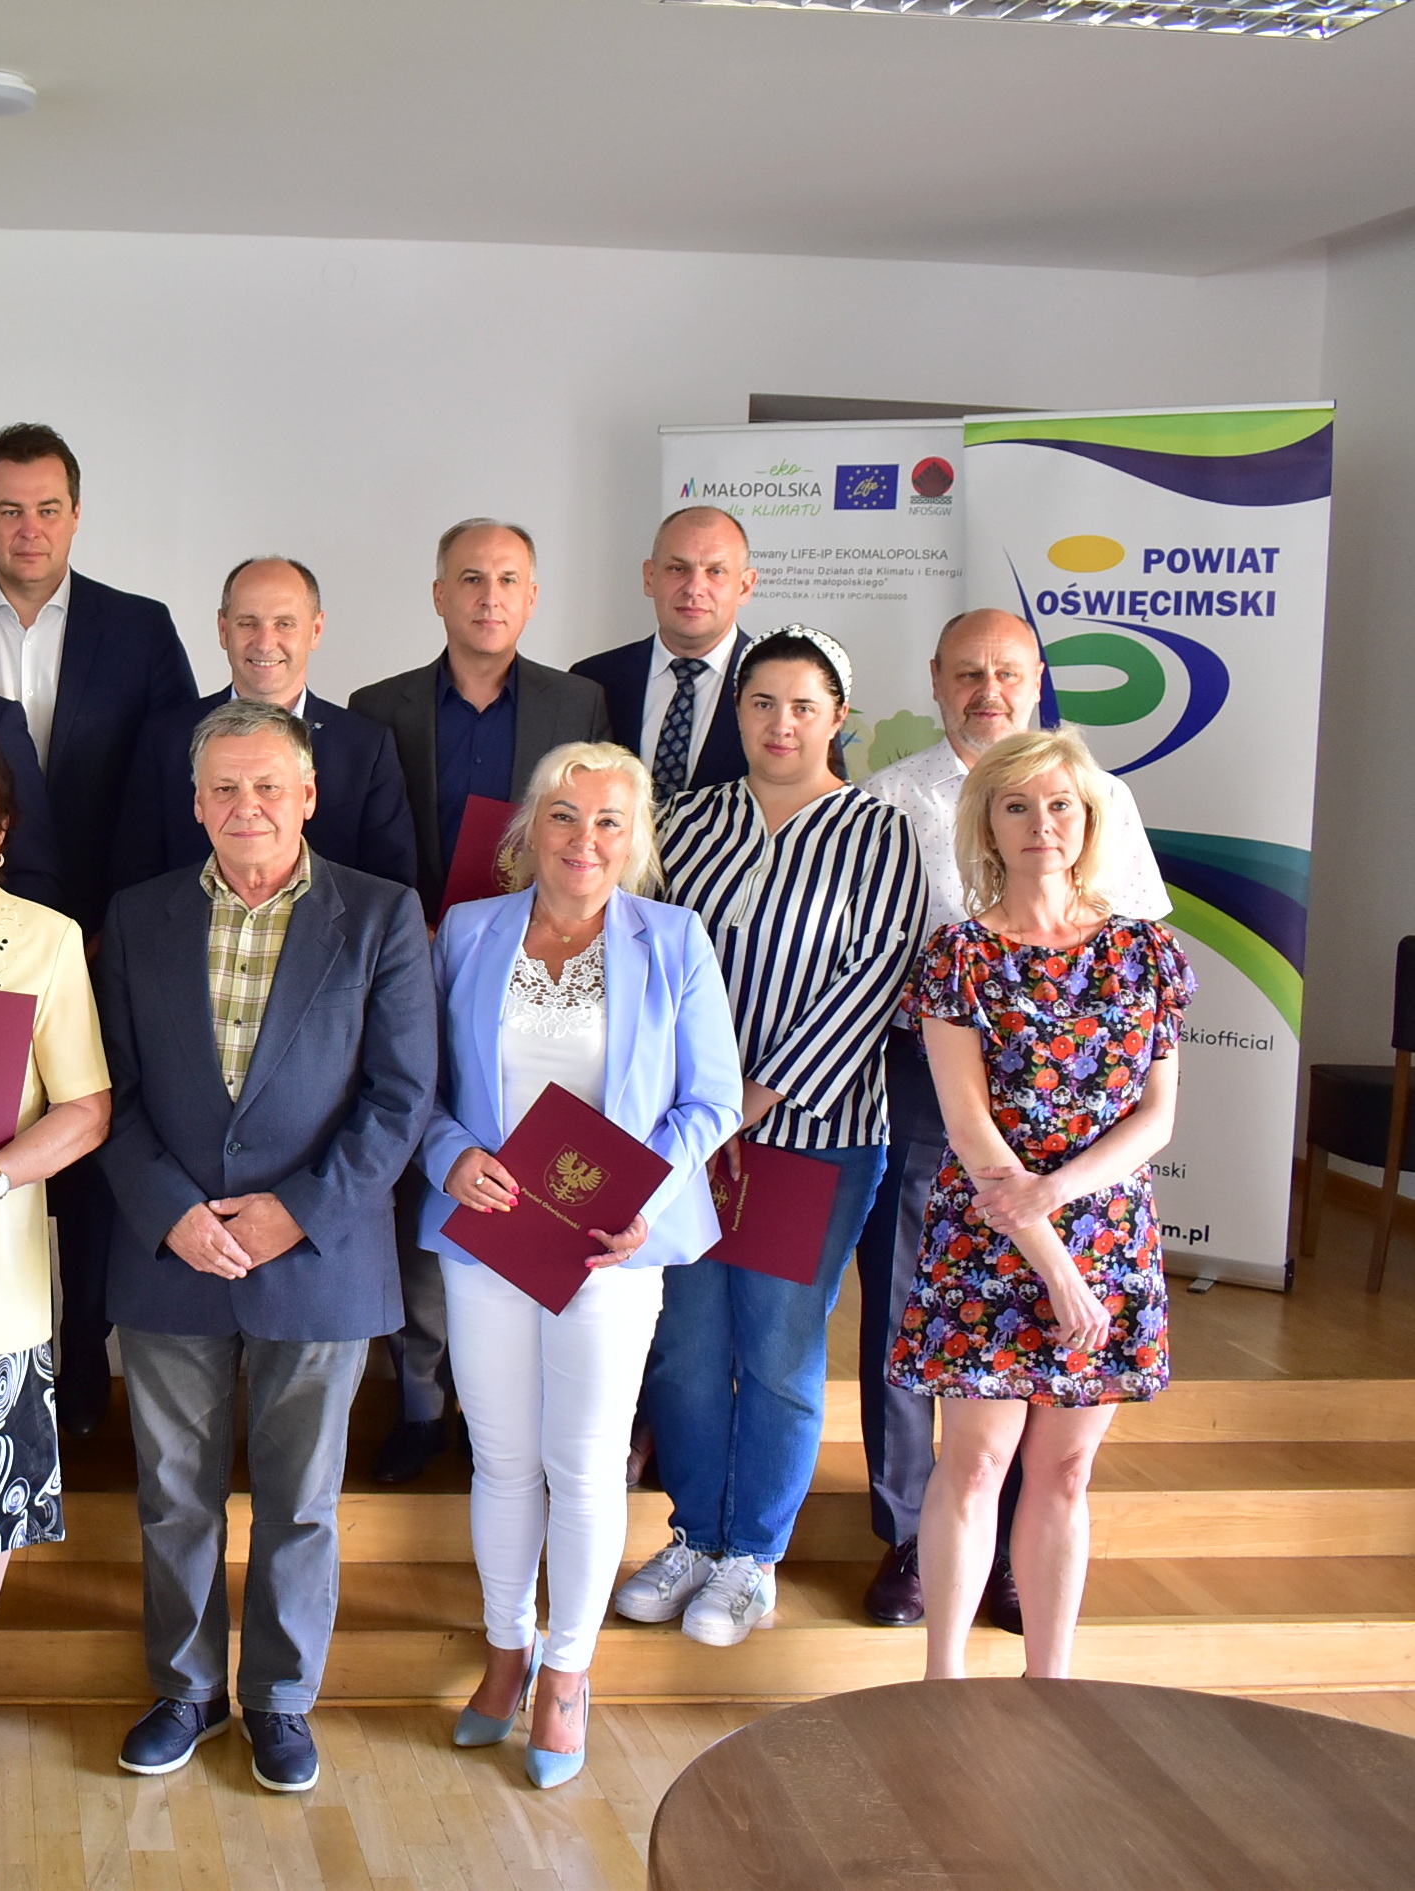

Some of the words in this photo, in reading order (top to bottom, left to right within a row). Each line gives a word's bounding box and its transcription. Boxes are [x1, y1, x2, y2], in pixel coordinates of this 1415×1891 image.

[702, 482, 822, 498] MAŁOPOLSKA
[752, 503, 822, 517] KLIMATU
[748, 550, 788, 560] rowany
[791, 548, 833, 559] LIFE-IP
[835, 548, 949, 560] EKOMALOPOLSKA
[1142, 547, 1281, 574] POWIAT
[757, 566, 784, 576] lnego
[786, 565, 815, 575] Planu
[817, 566, 855, 575] Działań
[857, 566, 873, 576] dla
[876, 567, 915, 576] Klimatu
[924, 567, 964, 579] Energii
[757, 578, 810, 587] jewództwa
[752, 591, 809, 599] MALOPOLSKA
[1035, 582, 1277, 623] OŚWIĘCIMSKI
[1180, 1026, 1275, 1051] skiofficial
[521, 1186, 543, 1204] Powiat
[1161, 1223, 1210, 1246] m.pl
